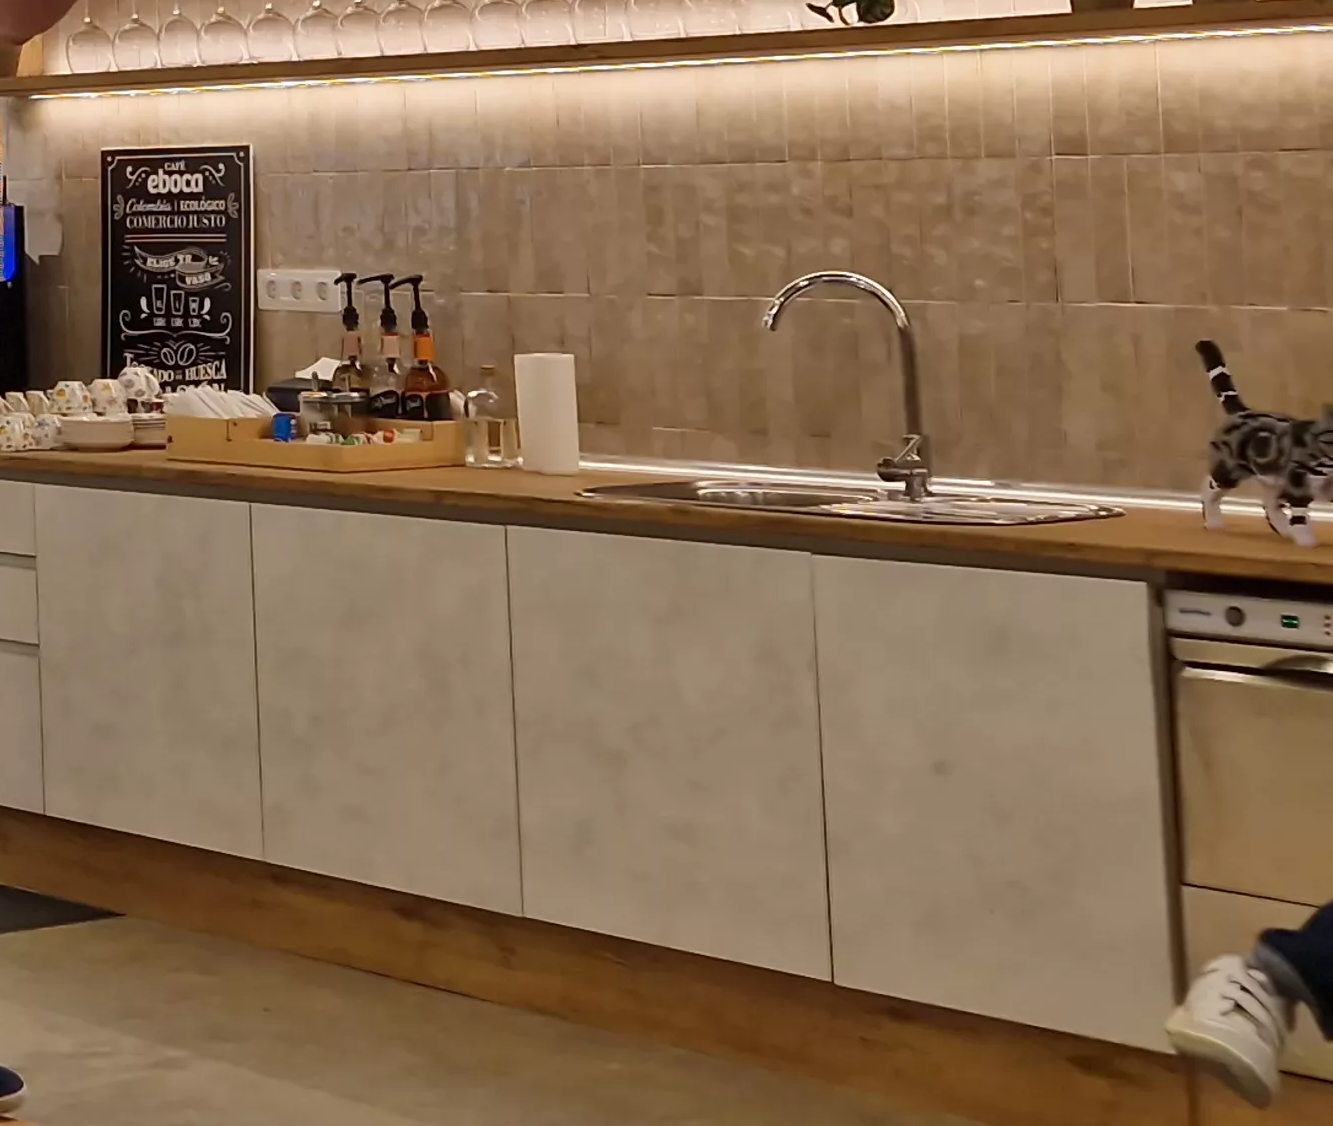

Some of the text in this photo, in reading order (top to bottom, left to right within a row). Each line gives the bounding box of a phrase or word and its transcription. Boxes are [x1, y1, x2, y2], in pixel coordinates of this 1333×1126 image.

[147, 168, 204, 194] eboca
[179, 195, 226, 212] ECOLÓGICO
[126, 215, 226, 229] COMERCIO JUSTO
[185, 358, 227, 381] HUESCA
